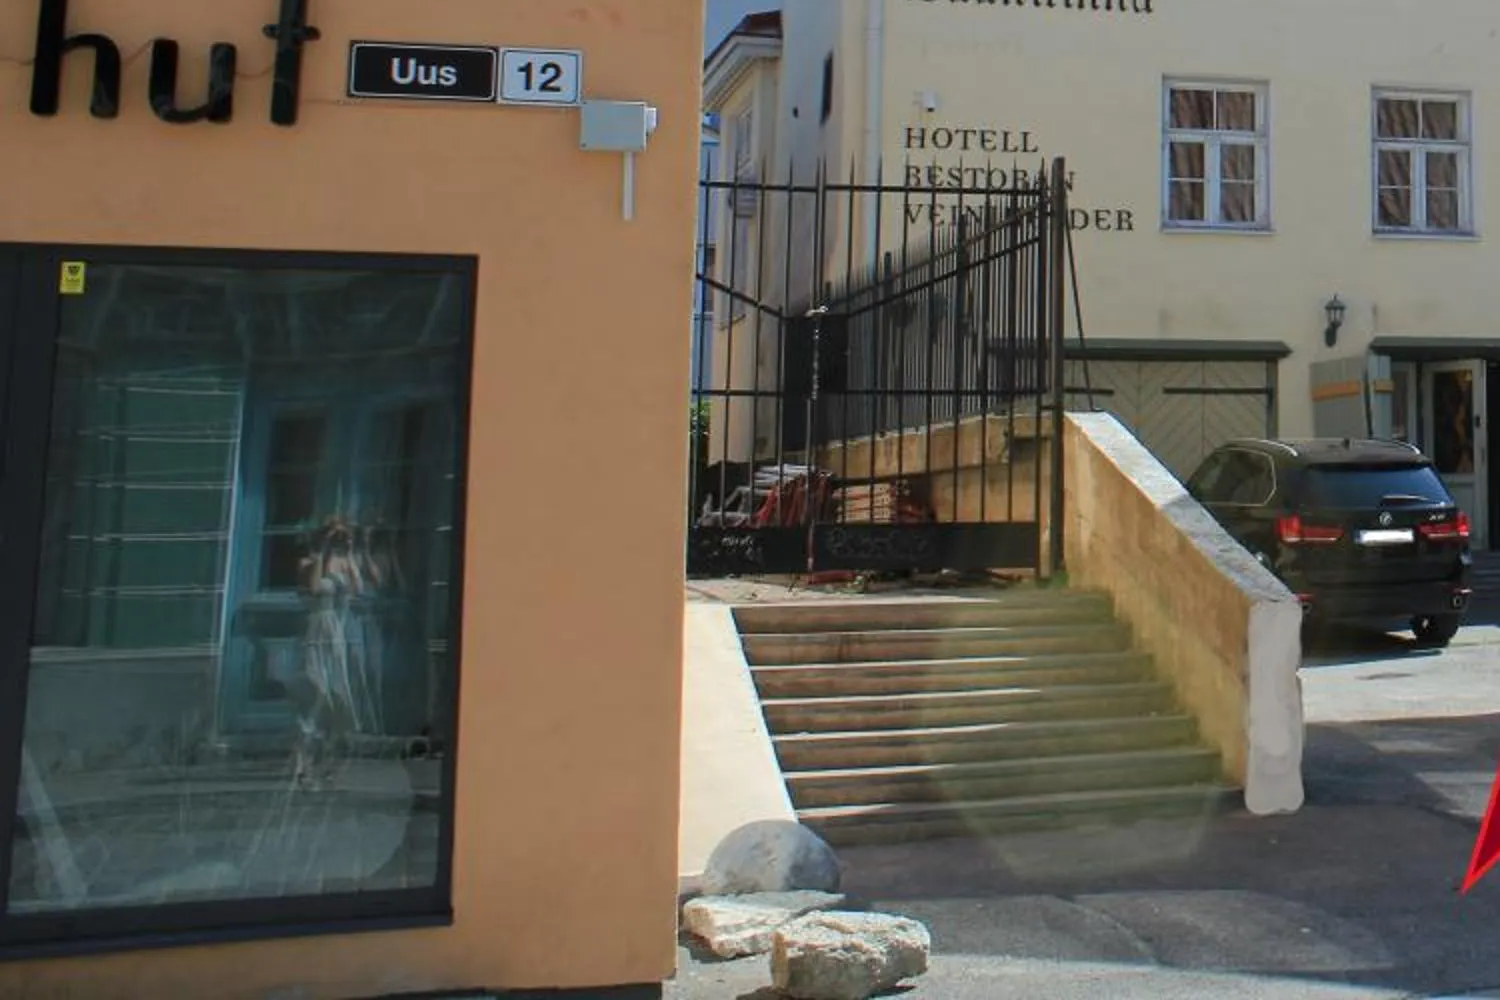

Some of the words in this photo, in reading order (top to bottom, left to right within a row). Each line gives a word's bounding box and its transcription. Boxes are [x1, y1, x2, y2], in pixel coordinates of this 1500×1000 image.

[391, 56, 458, 86] Uus
[517, 61, 563, 93] 12
[905, 127, 1039, 153] HOTELL
[904, 203, 1134, 231] VEINDER
